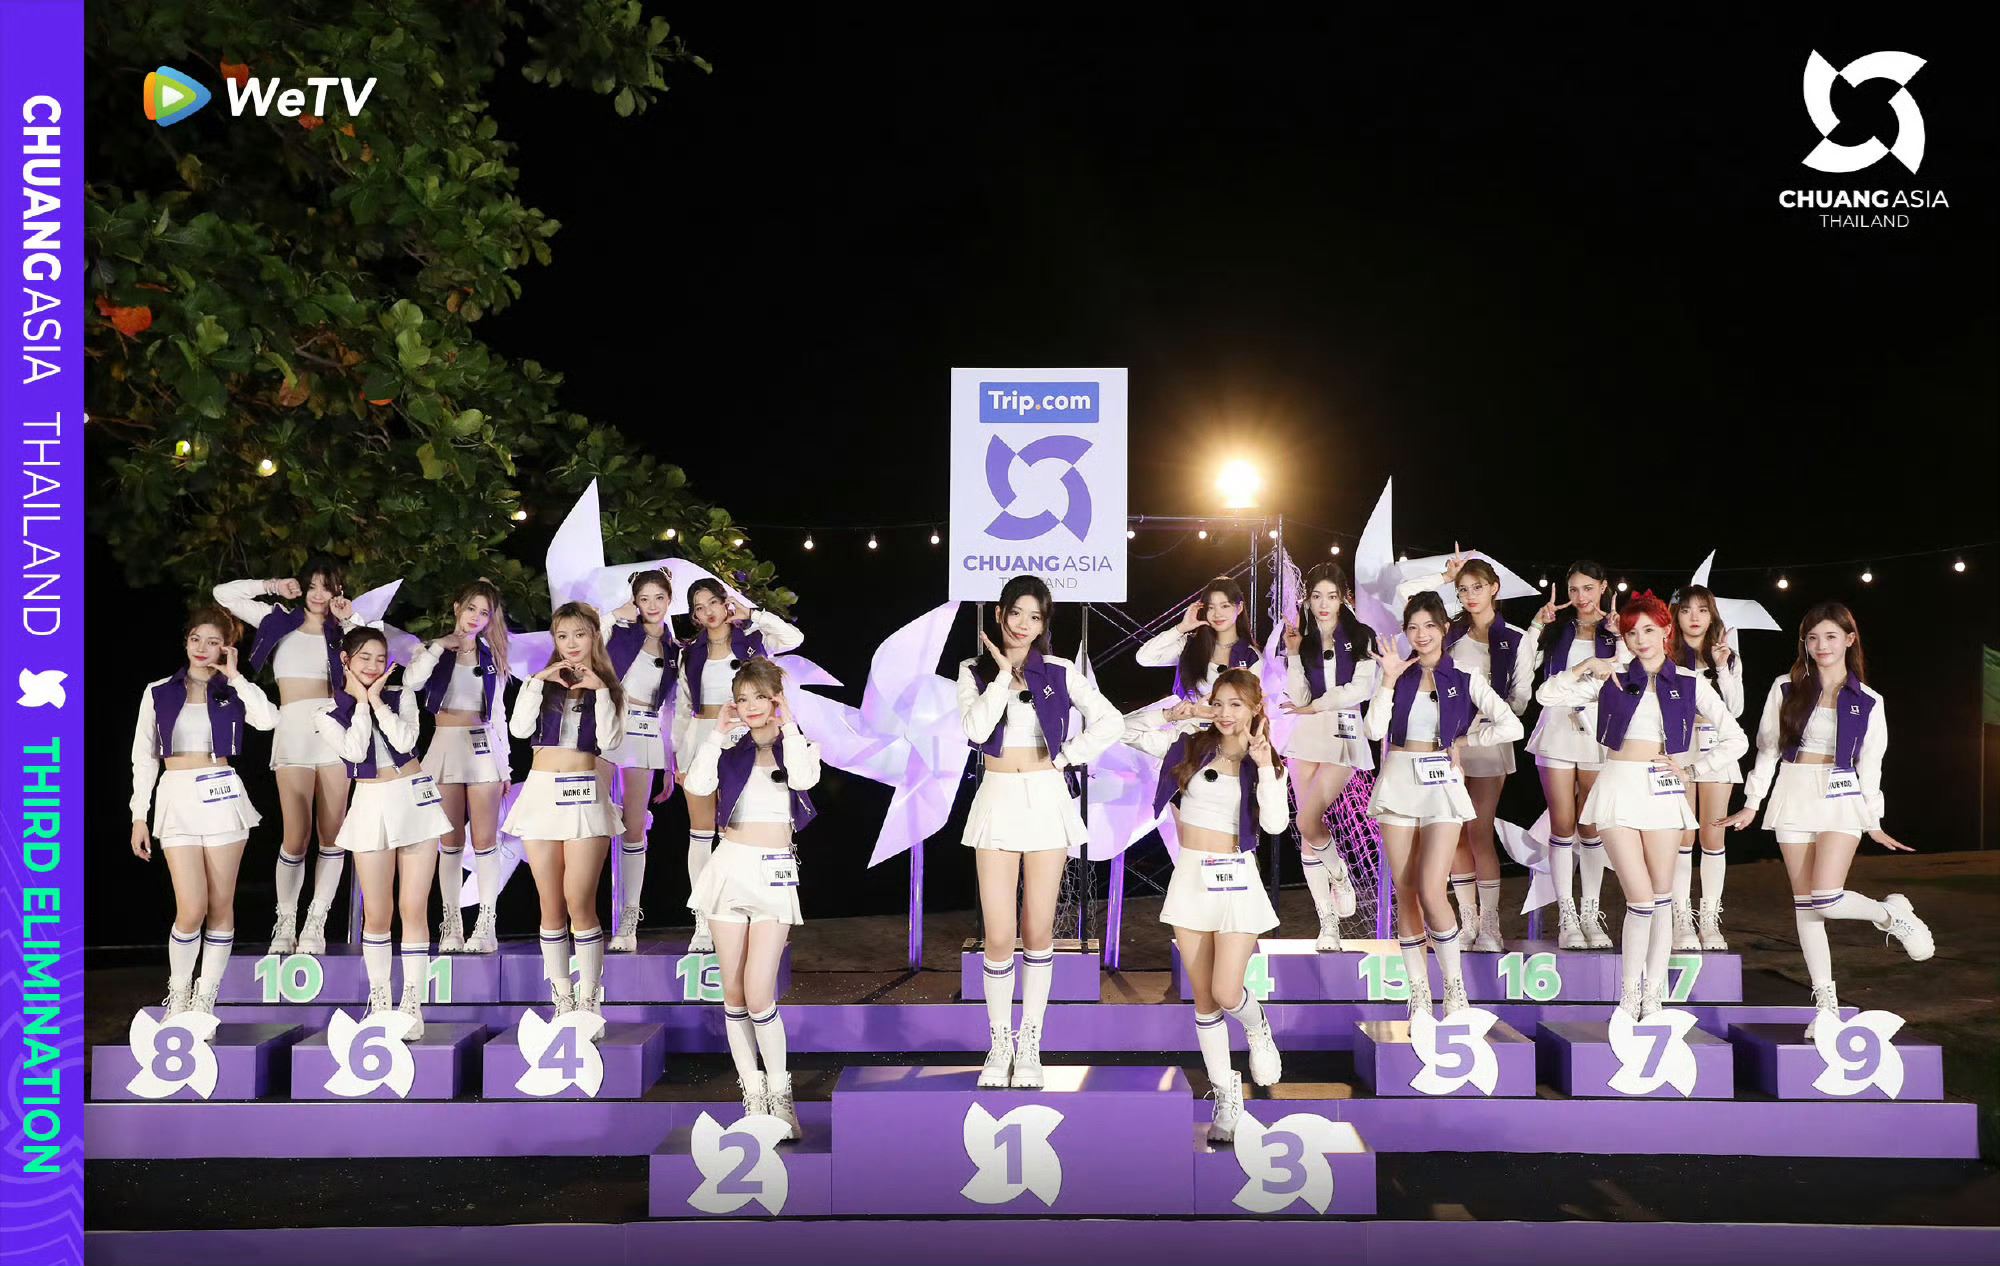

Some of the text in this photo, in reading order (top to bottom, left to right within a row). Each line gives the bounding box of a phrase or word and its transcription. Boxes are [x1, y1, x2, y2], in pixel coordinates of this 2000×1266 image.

[988, 390, 1091, 416] Trip.com
[562, 787, 591, 798] WANG KE
[1428, 770, 1445, 779] ELYN
[254, 954, 324, 1004] 10
[1243, 953, 1275, 1001] 4
[1358, 953, 1412, 1001] 15
[1497, 952, 1562, 1001] 16
[1661, 954, 1702, 1002] 7
[151, 1026, 196, 1082] 8
[348, 1026, 393, 1081] 6
[538, 1026, 585, 1079] 4
[1435, 1024, 1475, 1078] 5
[1632, 1025, 1672, 1078] 7
[1835, 1025, 1881, 1081] 9
[716, 1131, 763, 1194] 2
[993, 1124, 1023, 1185] 1
[1261, 1130, 1308, 1195] 3
